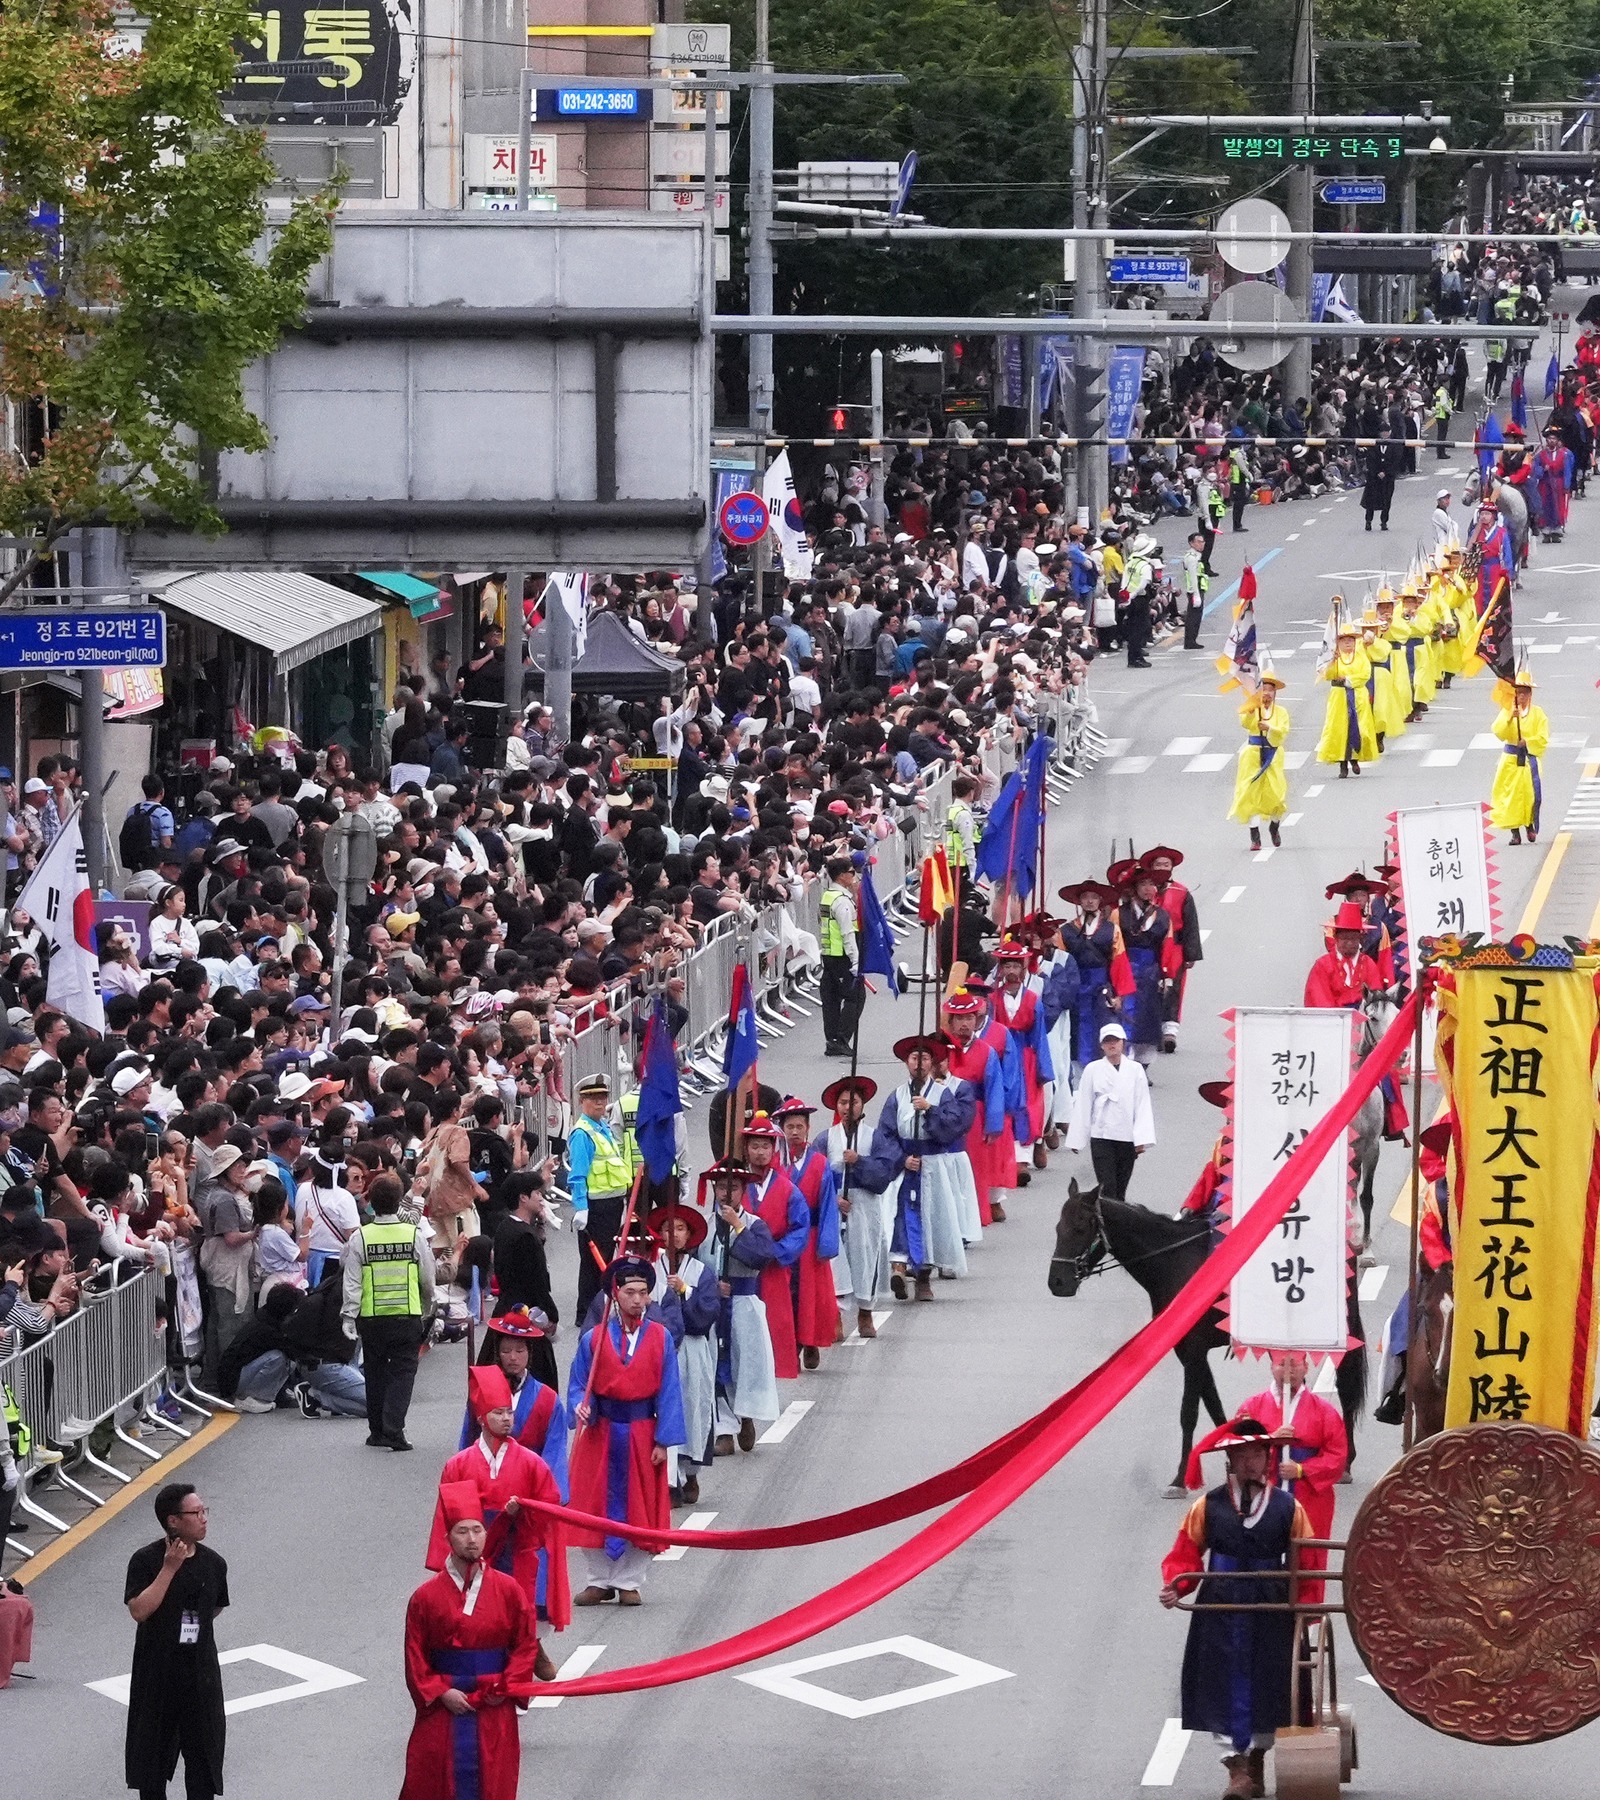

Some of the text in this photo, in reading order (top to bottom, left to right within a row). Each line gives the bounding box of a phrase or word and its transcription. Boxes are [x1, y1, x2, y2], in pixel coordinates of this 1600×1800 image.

[563, 92, 634, 111] 031-242-3650
[1223, 138, 1283, 158] 발생의
[1292, 138, 1331, 158] 경우
[1341, 138, 1380, 158] 단속
[493, 148, 547, 175] 치과
[727, 513, 762, 524] 주정차금지
[19, 650, 75, 663] Jeongjo-ro
[1427, 838, 1459, 860] 총리
[1430, 861, 1463, 883] 대신
[1437, 898, 1465, 933] 채
[1272, 1050, 1315, 1077] 경기
[1272, 1079, 1319, 1106] 감사
[1469, 977, 1548, 1422] 正祖大王花山陵
[367, 1244, 411, 1254] 자율방범대
